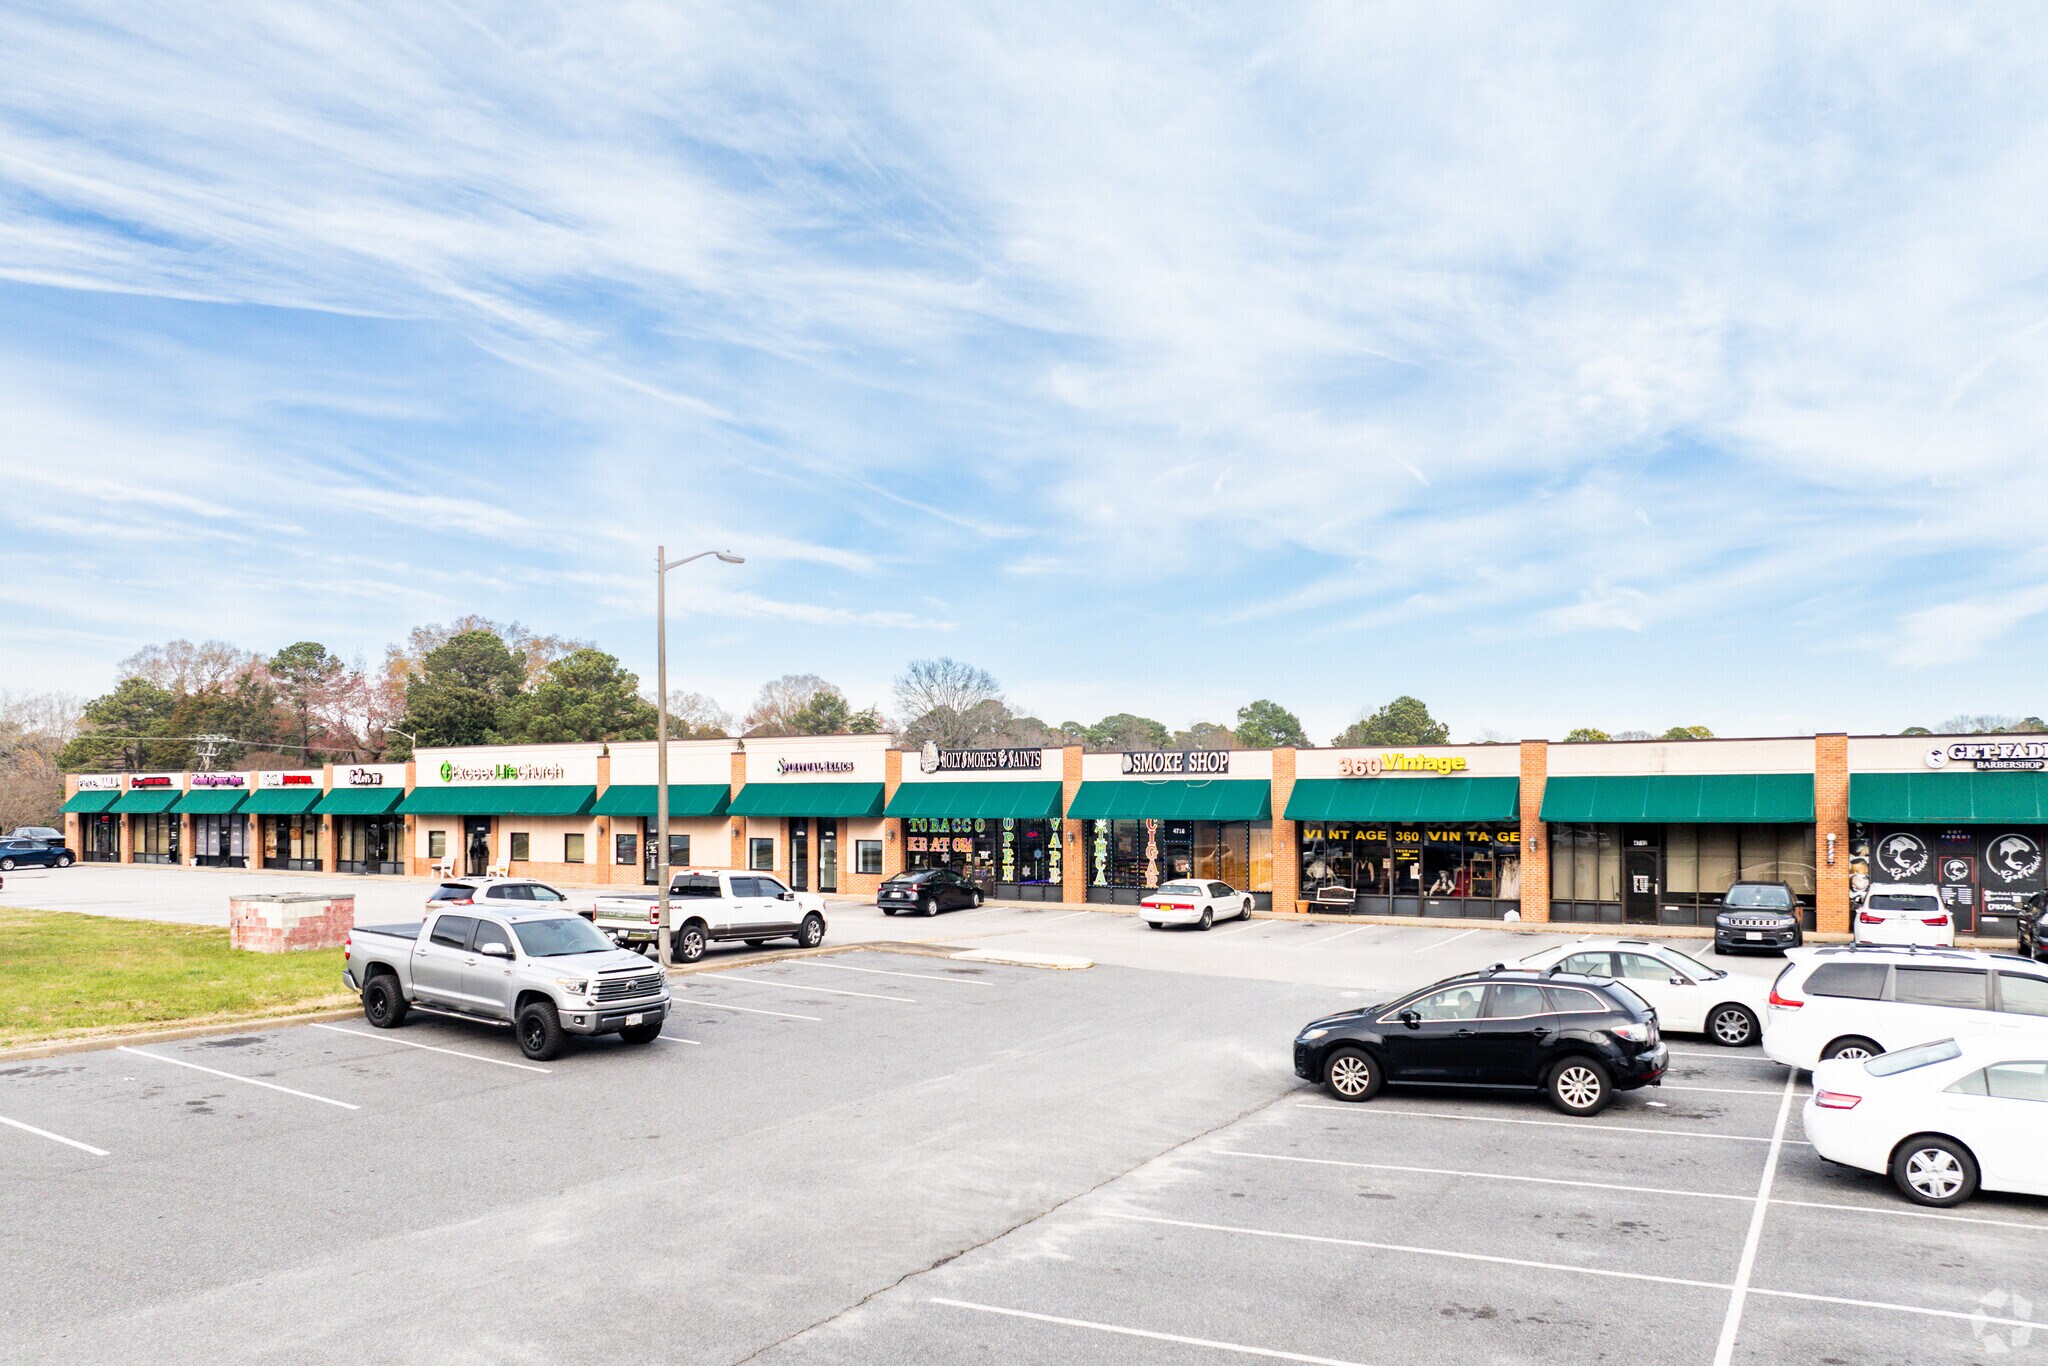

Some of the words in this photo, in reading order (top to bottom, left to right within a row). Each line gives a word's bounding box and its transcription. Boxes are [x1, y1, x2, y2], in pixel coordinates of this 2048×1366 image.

[941, 750, 961, 768] HOLY
[961, 750, 997, 768] SMOKES
[998, 749, 1007, 767] &
[1008, 749, 1041, 768] SAINTS
[1947, 743, 1995, 760] GET
[495, 763, 518, 780] Life
[518, 763, 564, 780] Church
[1133, 752, 1183, 773] SMOKE
[1189, 752, 1228, 772] SHOP
[1339, 756, 1382, 776] 360
[1382, 753, 1466, 775] Vintage
[1976, 761, 2043, 769] BARBERSHOP
[1395, 831, 1420, 842] 360
[1002, 818, 1015, 883] OPEN
[1048, 818, 1062, 884] VAPE
[1093, 826, 1108, 886] THCA
